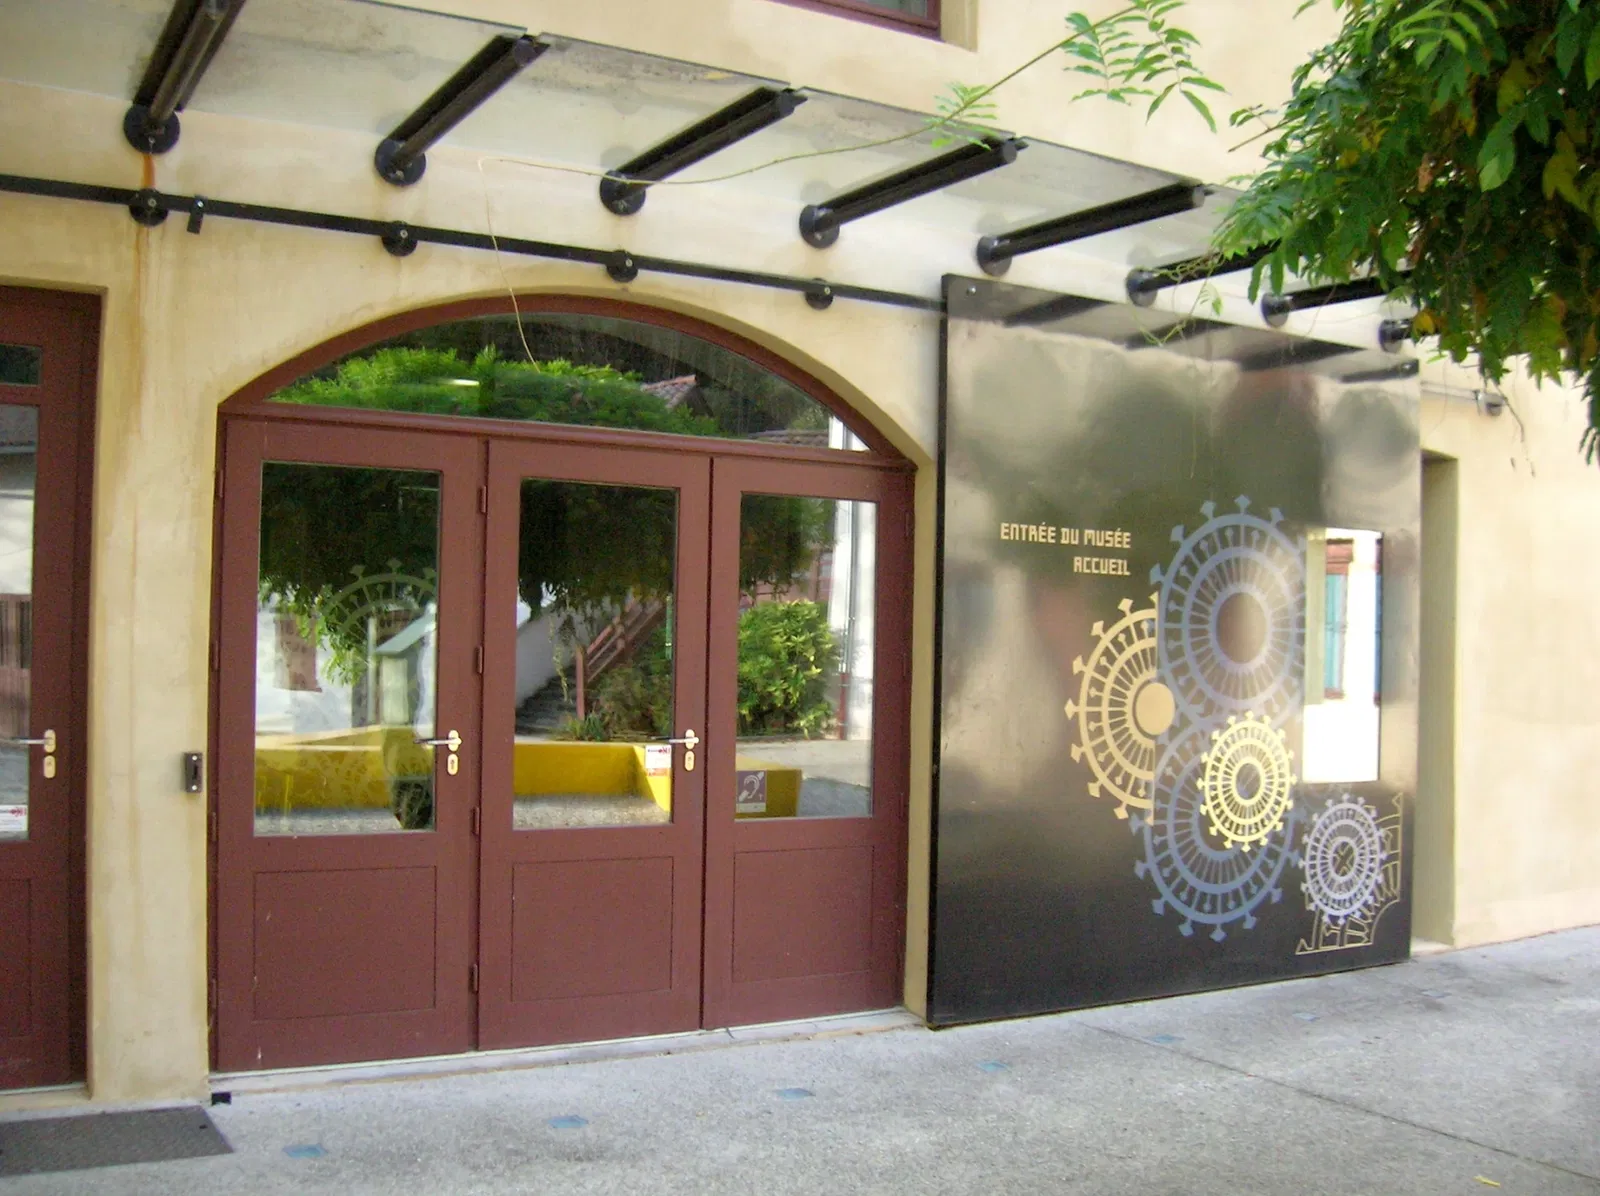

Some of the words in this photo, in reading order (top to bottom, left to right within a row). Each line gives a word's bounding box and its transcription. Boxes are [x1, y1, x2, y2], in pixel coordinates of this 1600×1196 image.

[1000, 522, 1056, 544] ENTRÉE
[1060, 527, 1079, 545] DU
[1084, 528, 1131, 548] MUSÉE
[1073, 556, 1131, 576] ACCUEIL
